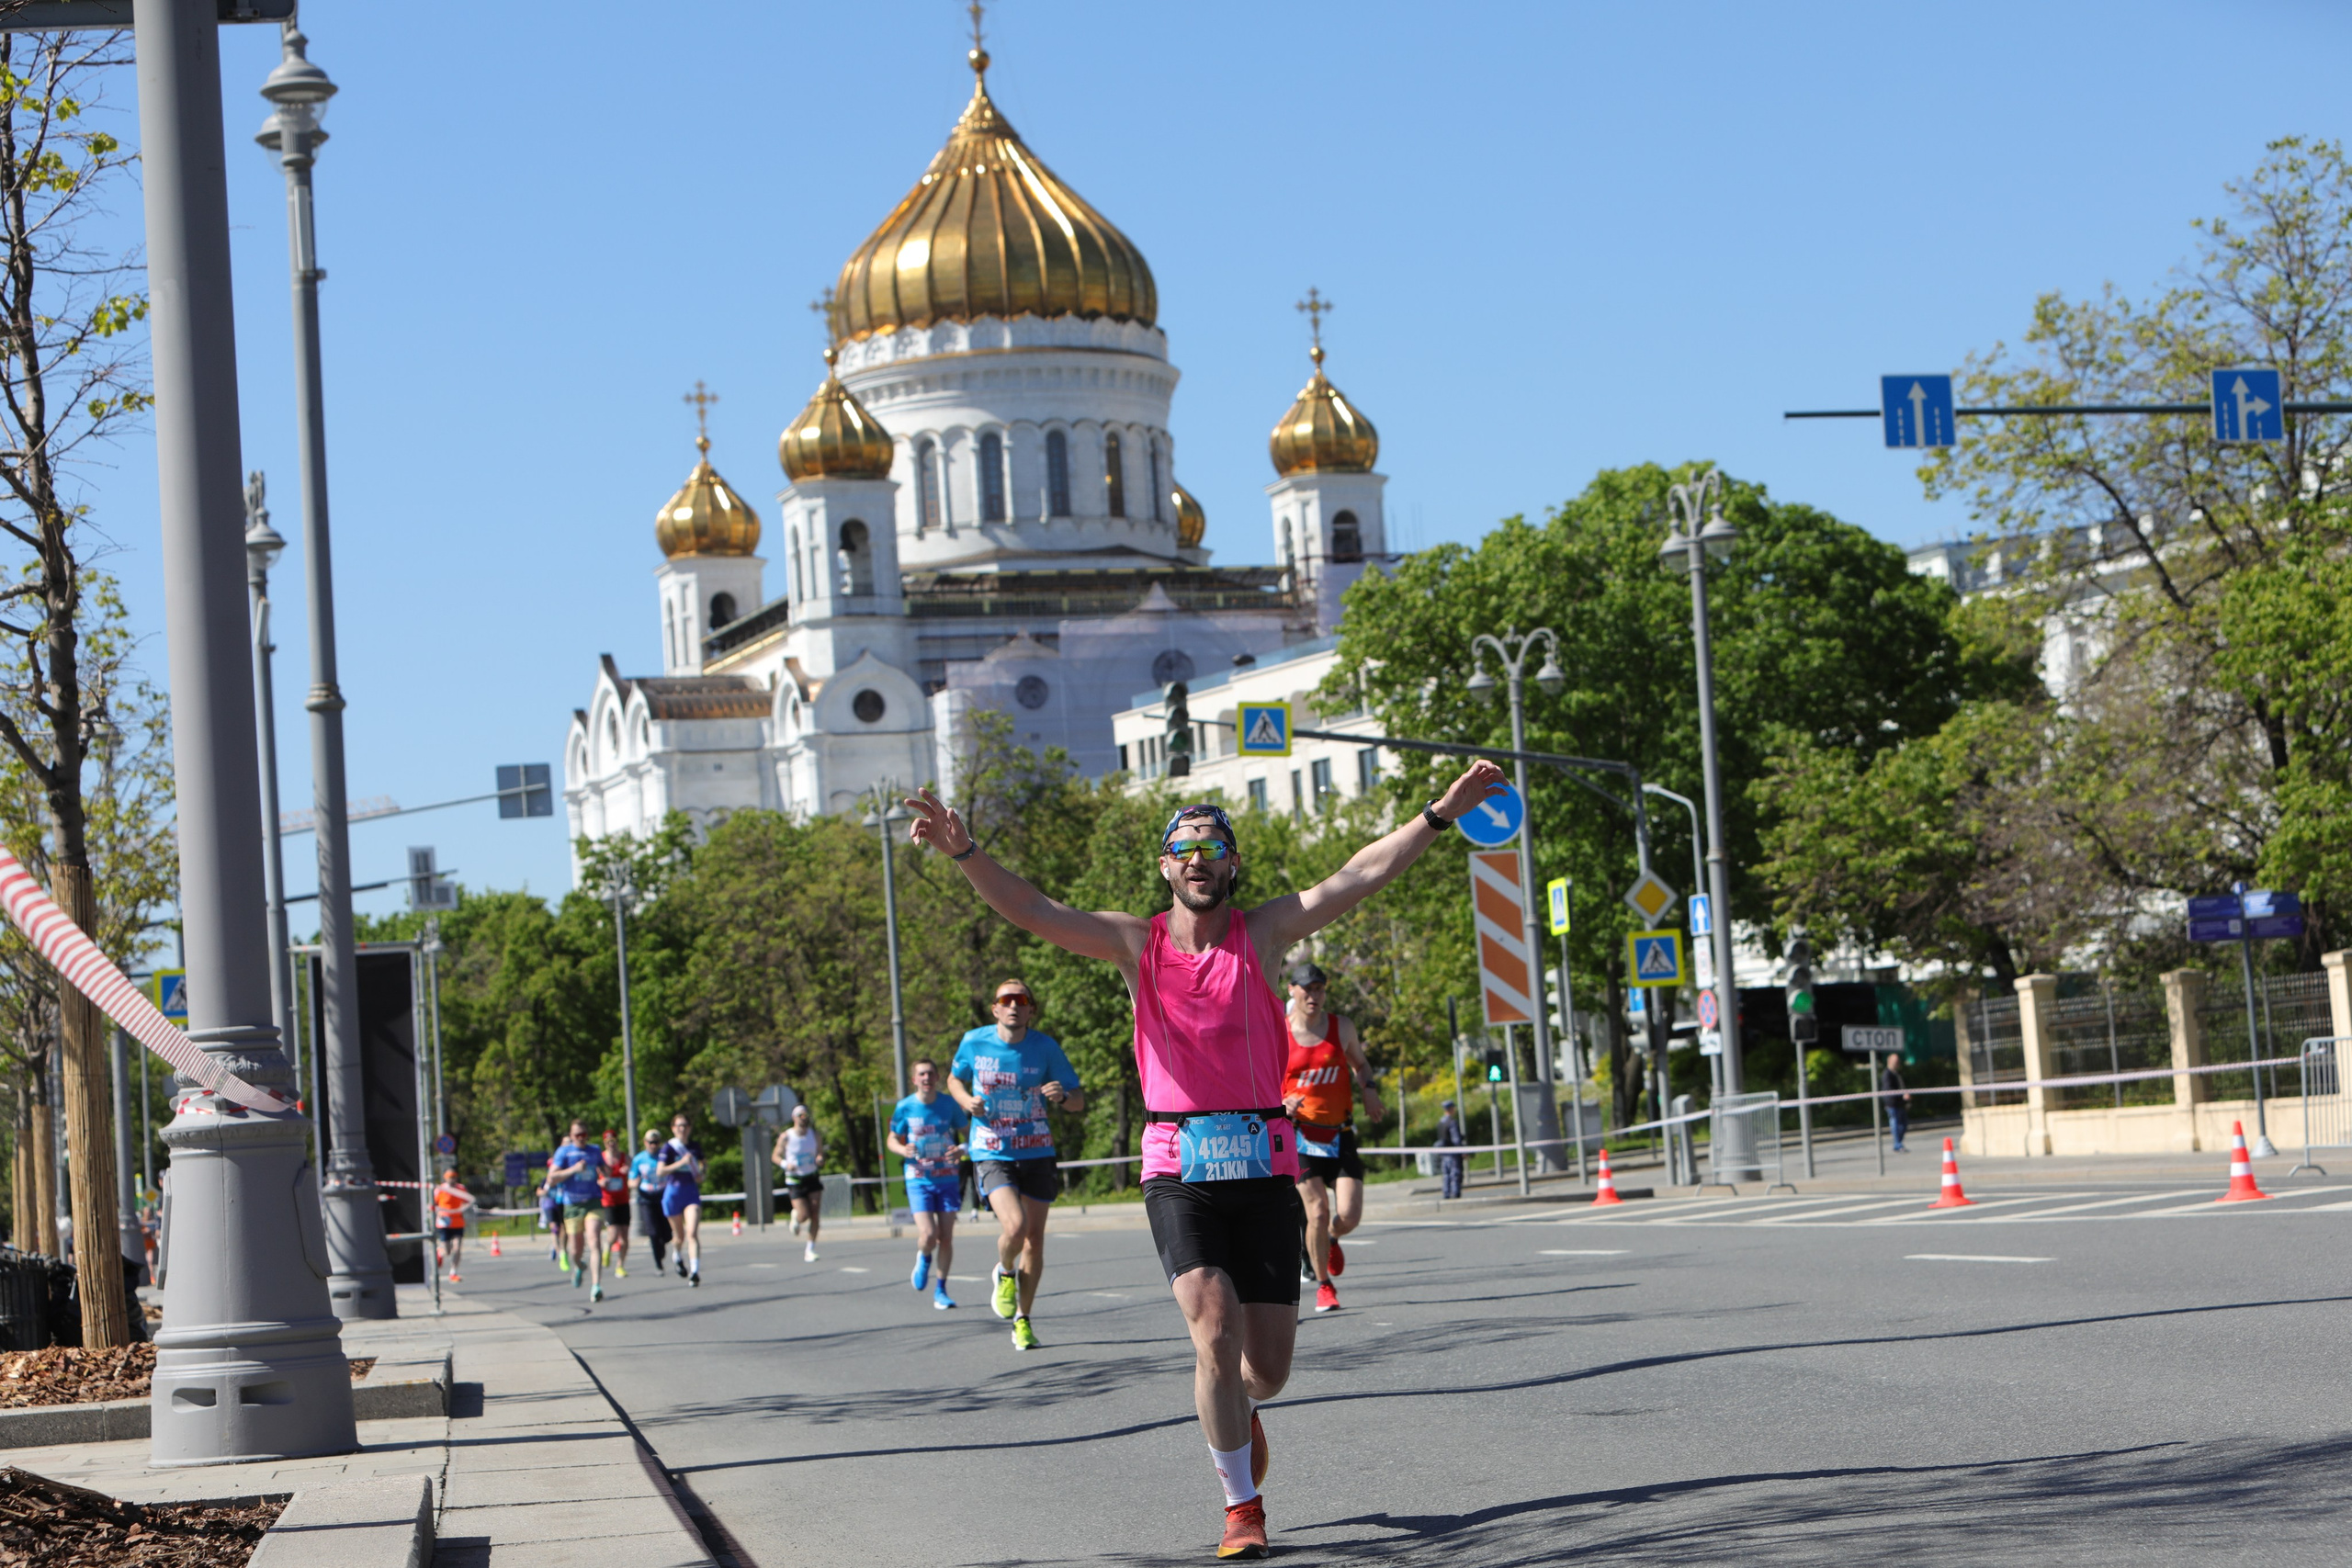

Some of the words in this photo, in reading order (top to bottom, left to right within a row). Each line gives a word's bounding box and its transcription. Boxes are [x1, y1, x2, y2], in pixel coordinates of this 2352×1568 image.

[1852, 1031, 1896, 1046] СТОП
[974, 1055, 1000, 1072] 2024
[1250, 1123, 1259, 1133] A
[1198, 1134, 1251, 1160] 41245
[1205, 1160, 1249, 1181] 21.1KM
